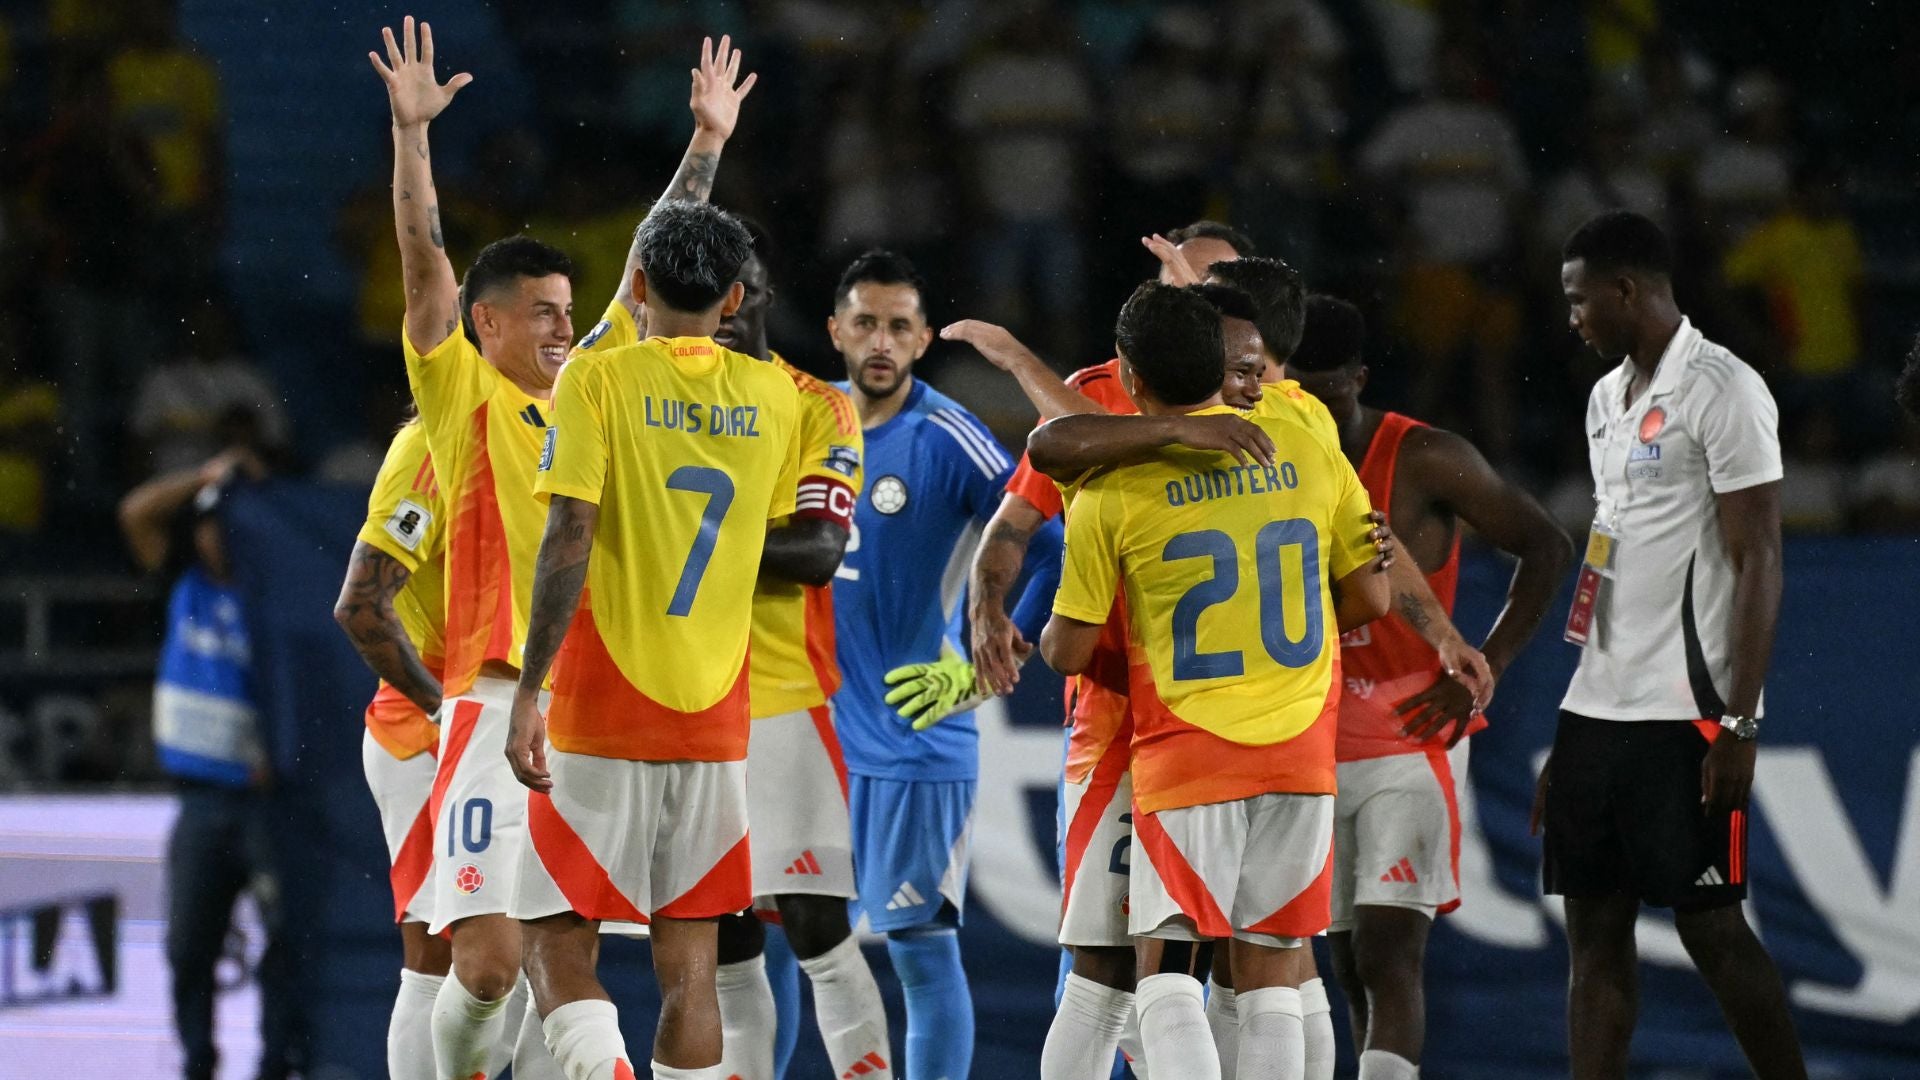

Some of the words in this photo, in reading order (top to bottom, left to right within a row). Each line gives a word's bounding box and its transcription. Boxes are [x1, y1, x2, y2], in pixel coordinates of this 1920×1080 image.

[673, 344, 714, 358] COLOMBIA
[644, 396, 703, 434] LUIS
[709, 405, 760, 437] DIAZ
[829, 486, 852, 517] C
[1165, 461, 1299, 507] QUINTERO
[665, 464, 736, 618] 7
[1161, 517, 1325, 682] 20
[447, 797, 493, 858] 10
